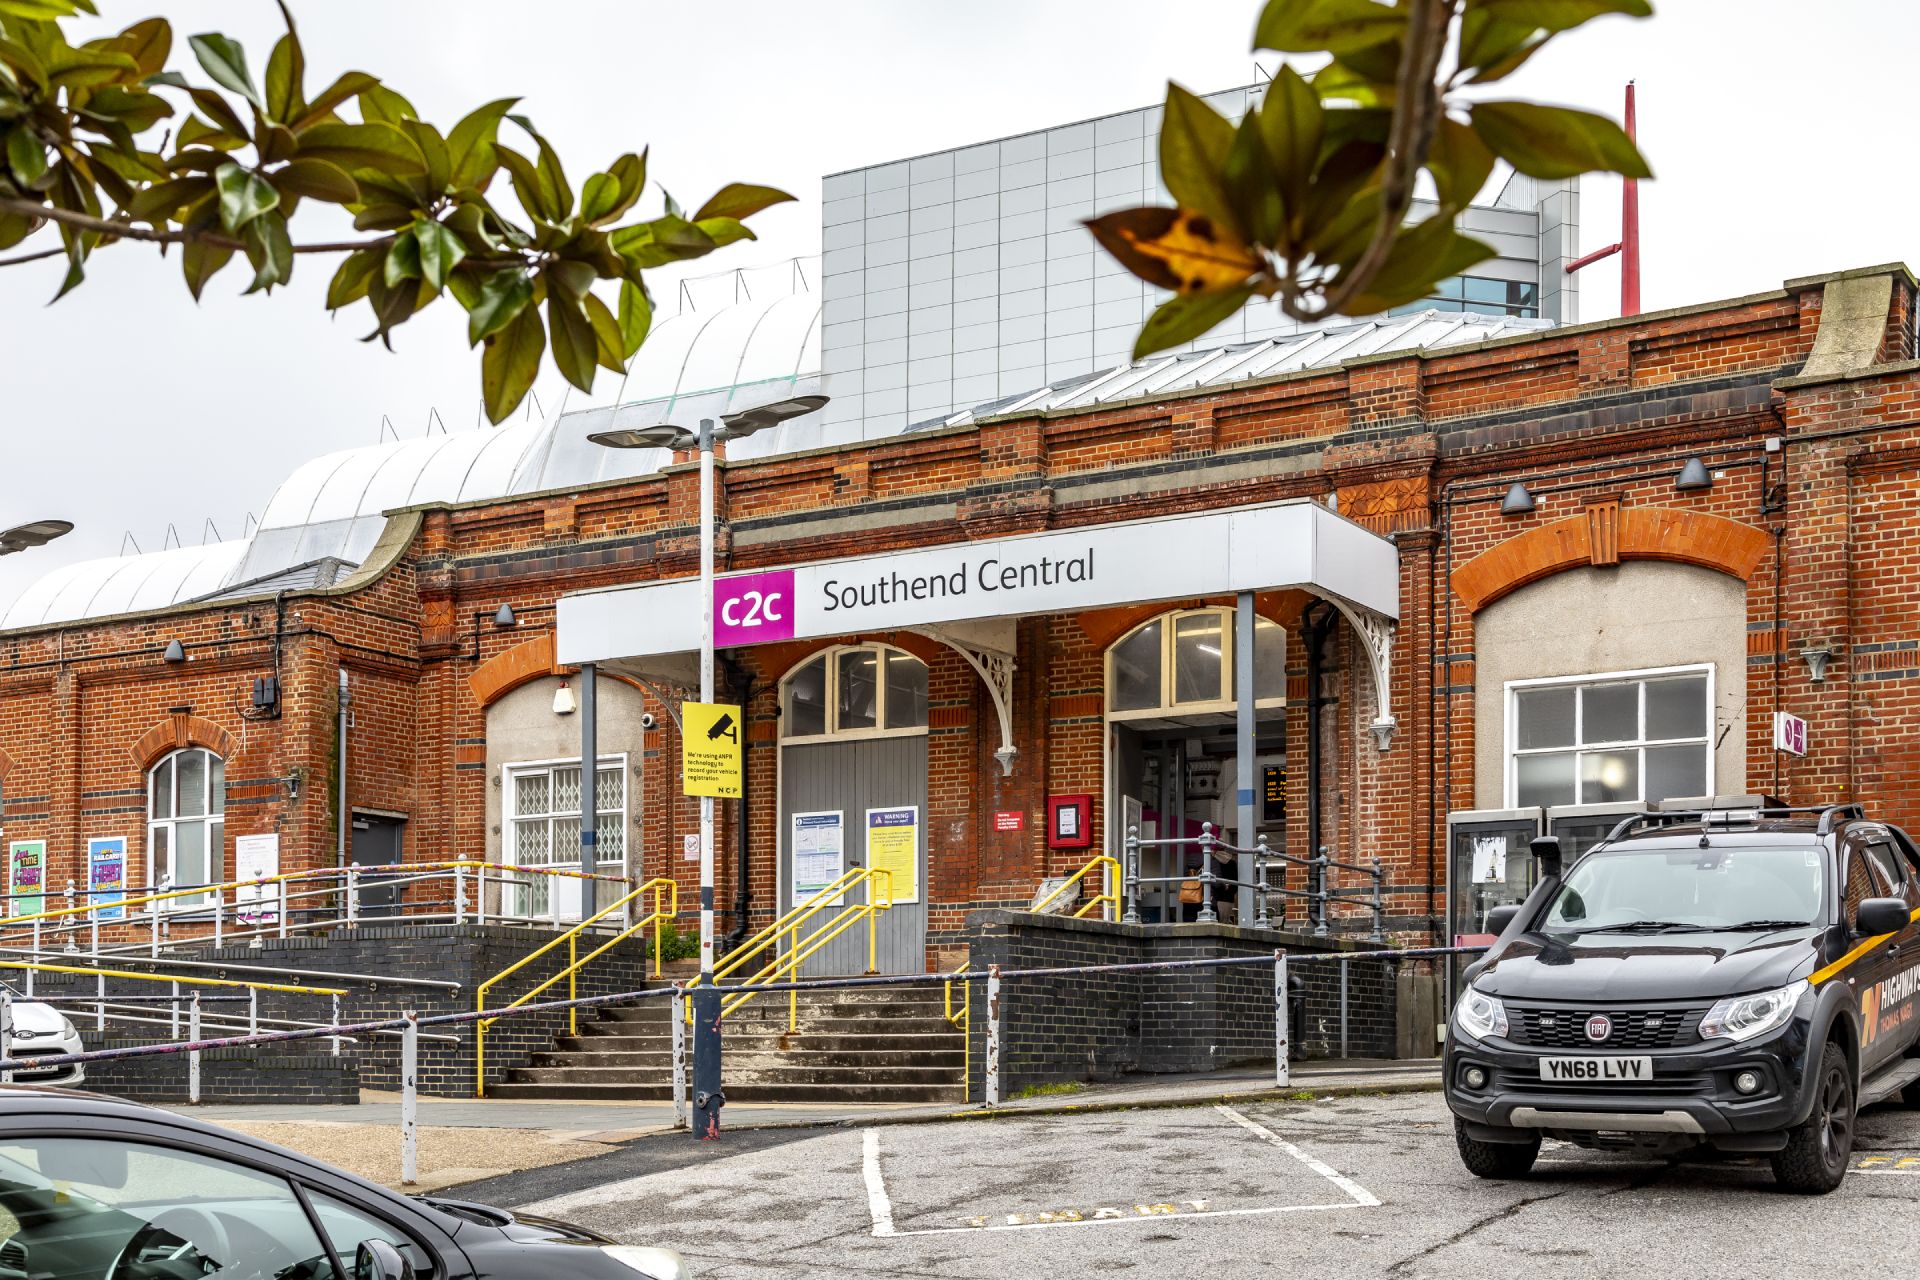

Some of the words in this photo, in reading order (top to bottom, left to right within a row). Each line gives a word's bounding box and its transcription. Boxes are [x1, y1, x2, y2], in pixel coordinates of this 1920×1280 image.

[823, 562, 967, 612] Southend
[978, 548, 1094, 592] Central
[721, 591, 782, 627] c2c
[688, 760, 717, 768] technology
[884, 812, 909, 820] WARNING
[22, 855, 38, 866] TIME
[1591, 1023, 1606, 1035] FIAT
[1548, 1060, 1599, 1079] YN68
[1603, 1060, 1642, 1078] LVV
